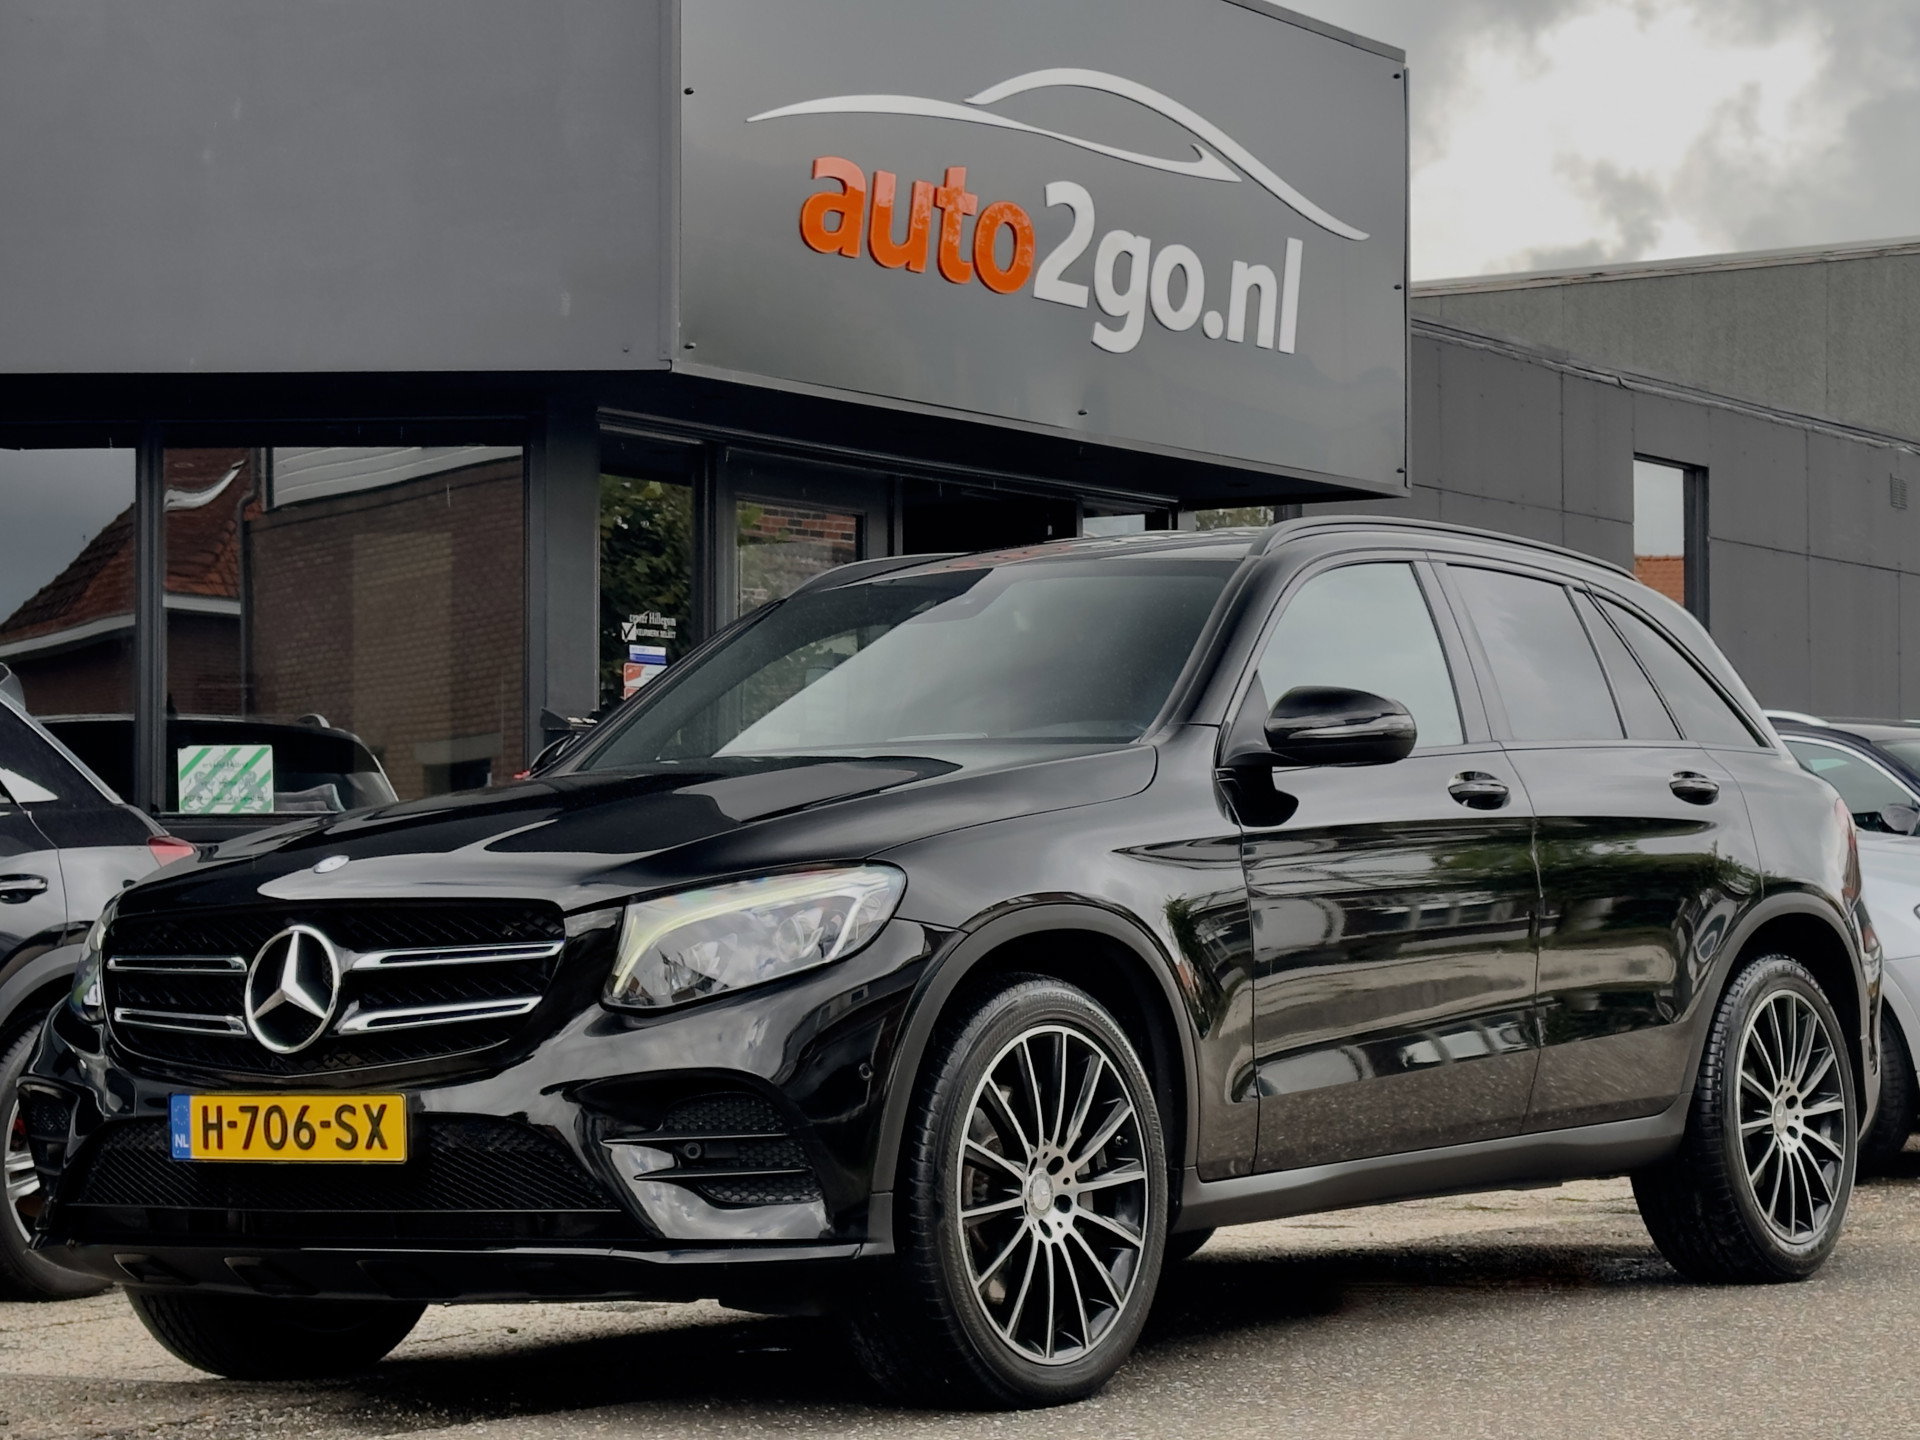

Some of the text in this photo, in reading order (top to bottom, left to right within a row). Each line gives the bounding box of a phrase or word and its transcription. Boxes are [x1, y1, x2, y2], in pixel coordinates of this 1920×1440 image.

[800, 156, 1303, 354] auto2go.nl
[649, 612, 677, 630] Hillegom
[174, 1104, 389, 1151] NL H-706-SX
